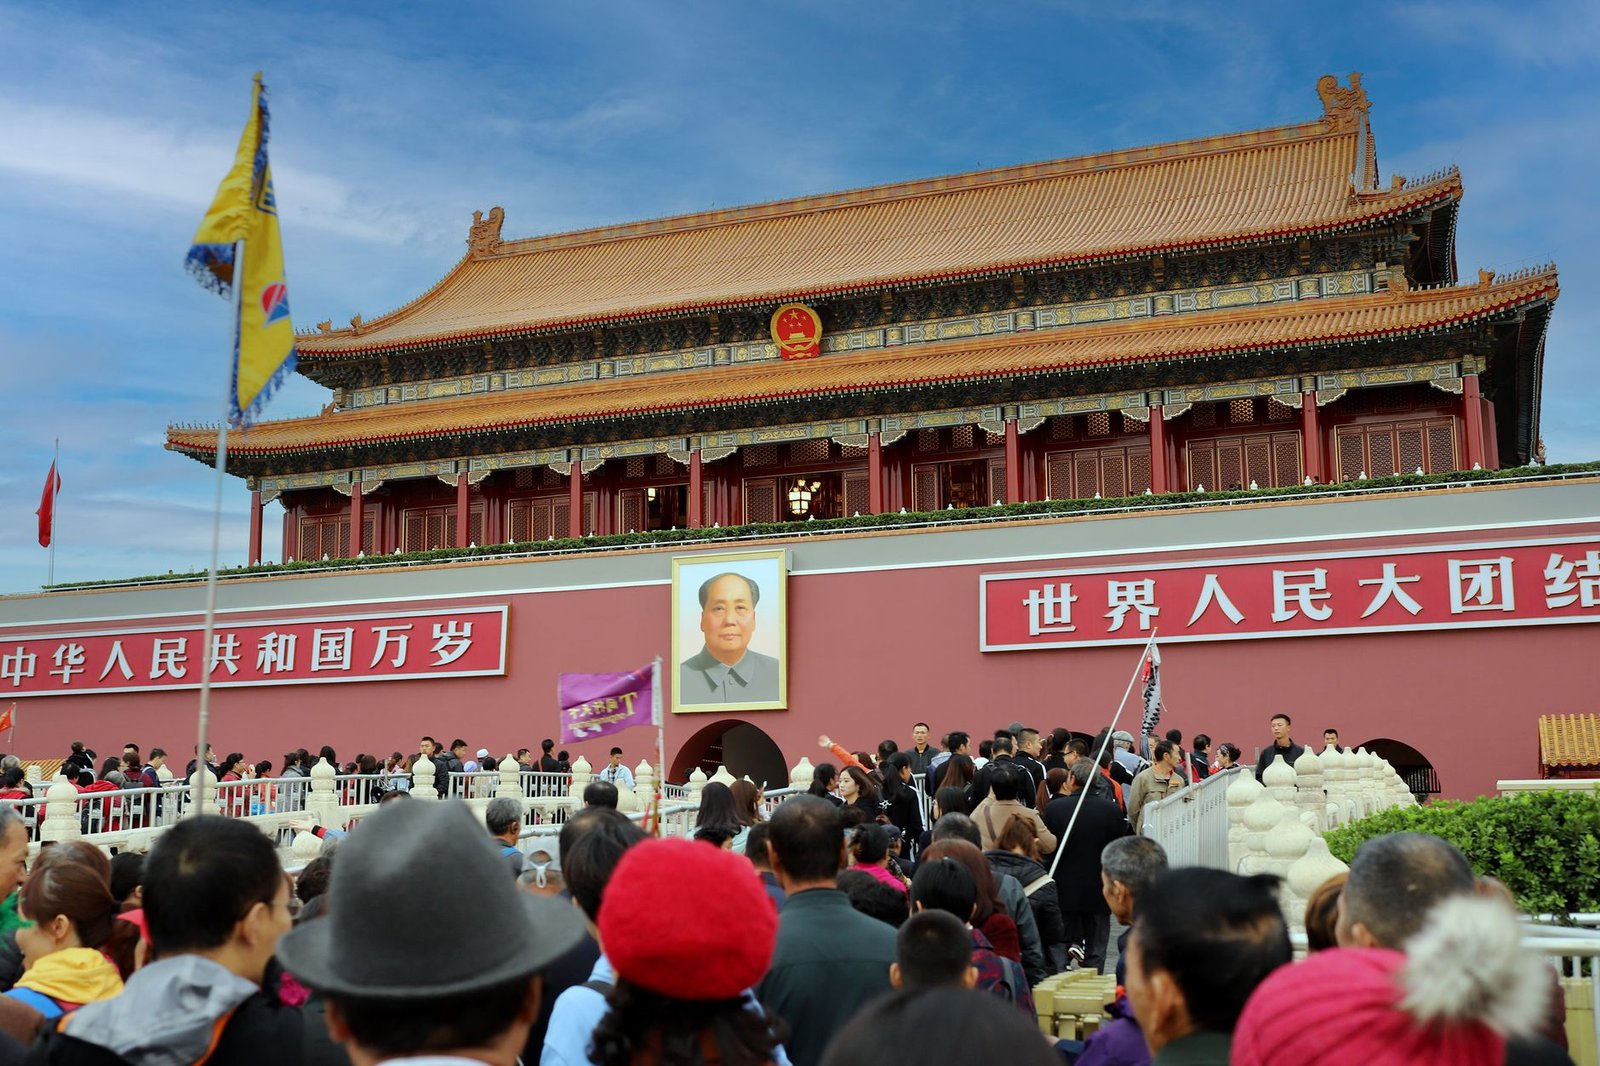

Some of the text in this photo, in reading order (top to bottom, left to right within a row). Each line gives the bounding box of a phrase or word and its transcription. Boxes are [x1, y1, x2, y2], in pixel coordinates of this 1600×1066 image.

[1022, 550, 1600, 636] 世界人民大团结
[1, 620, 474, 687] 中华人民共和国万岁
